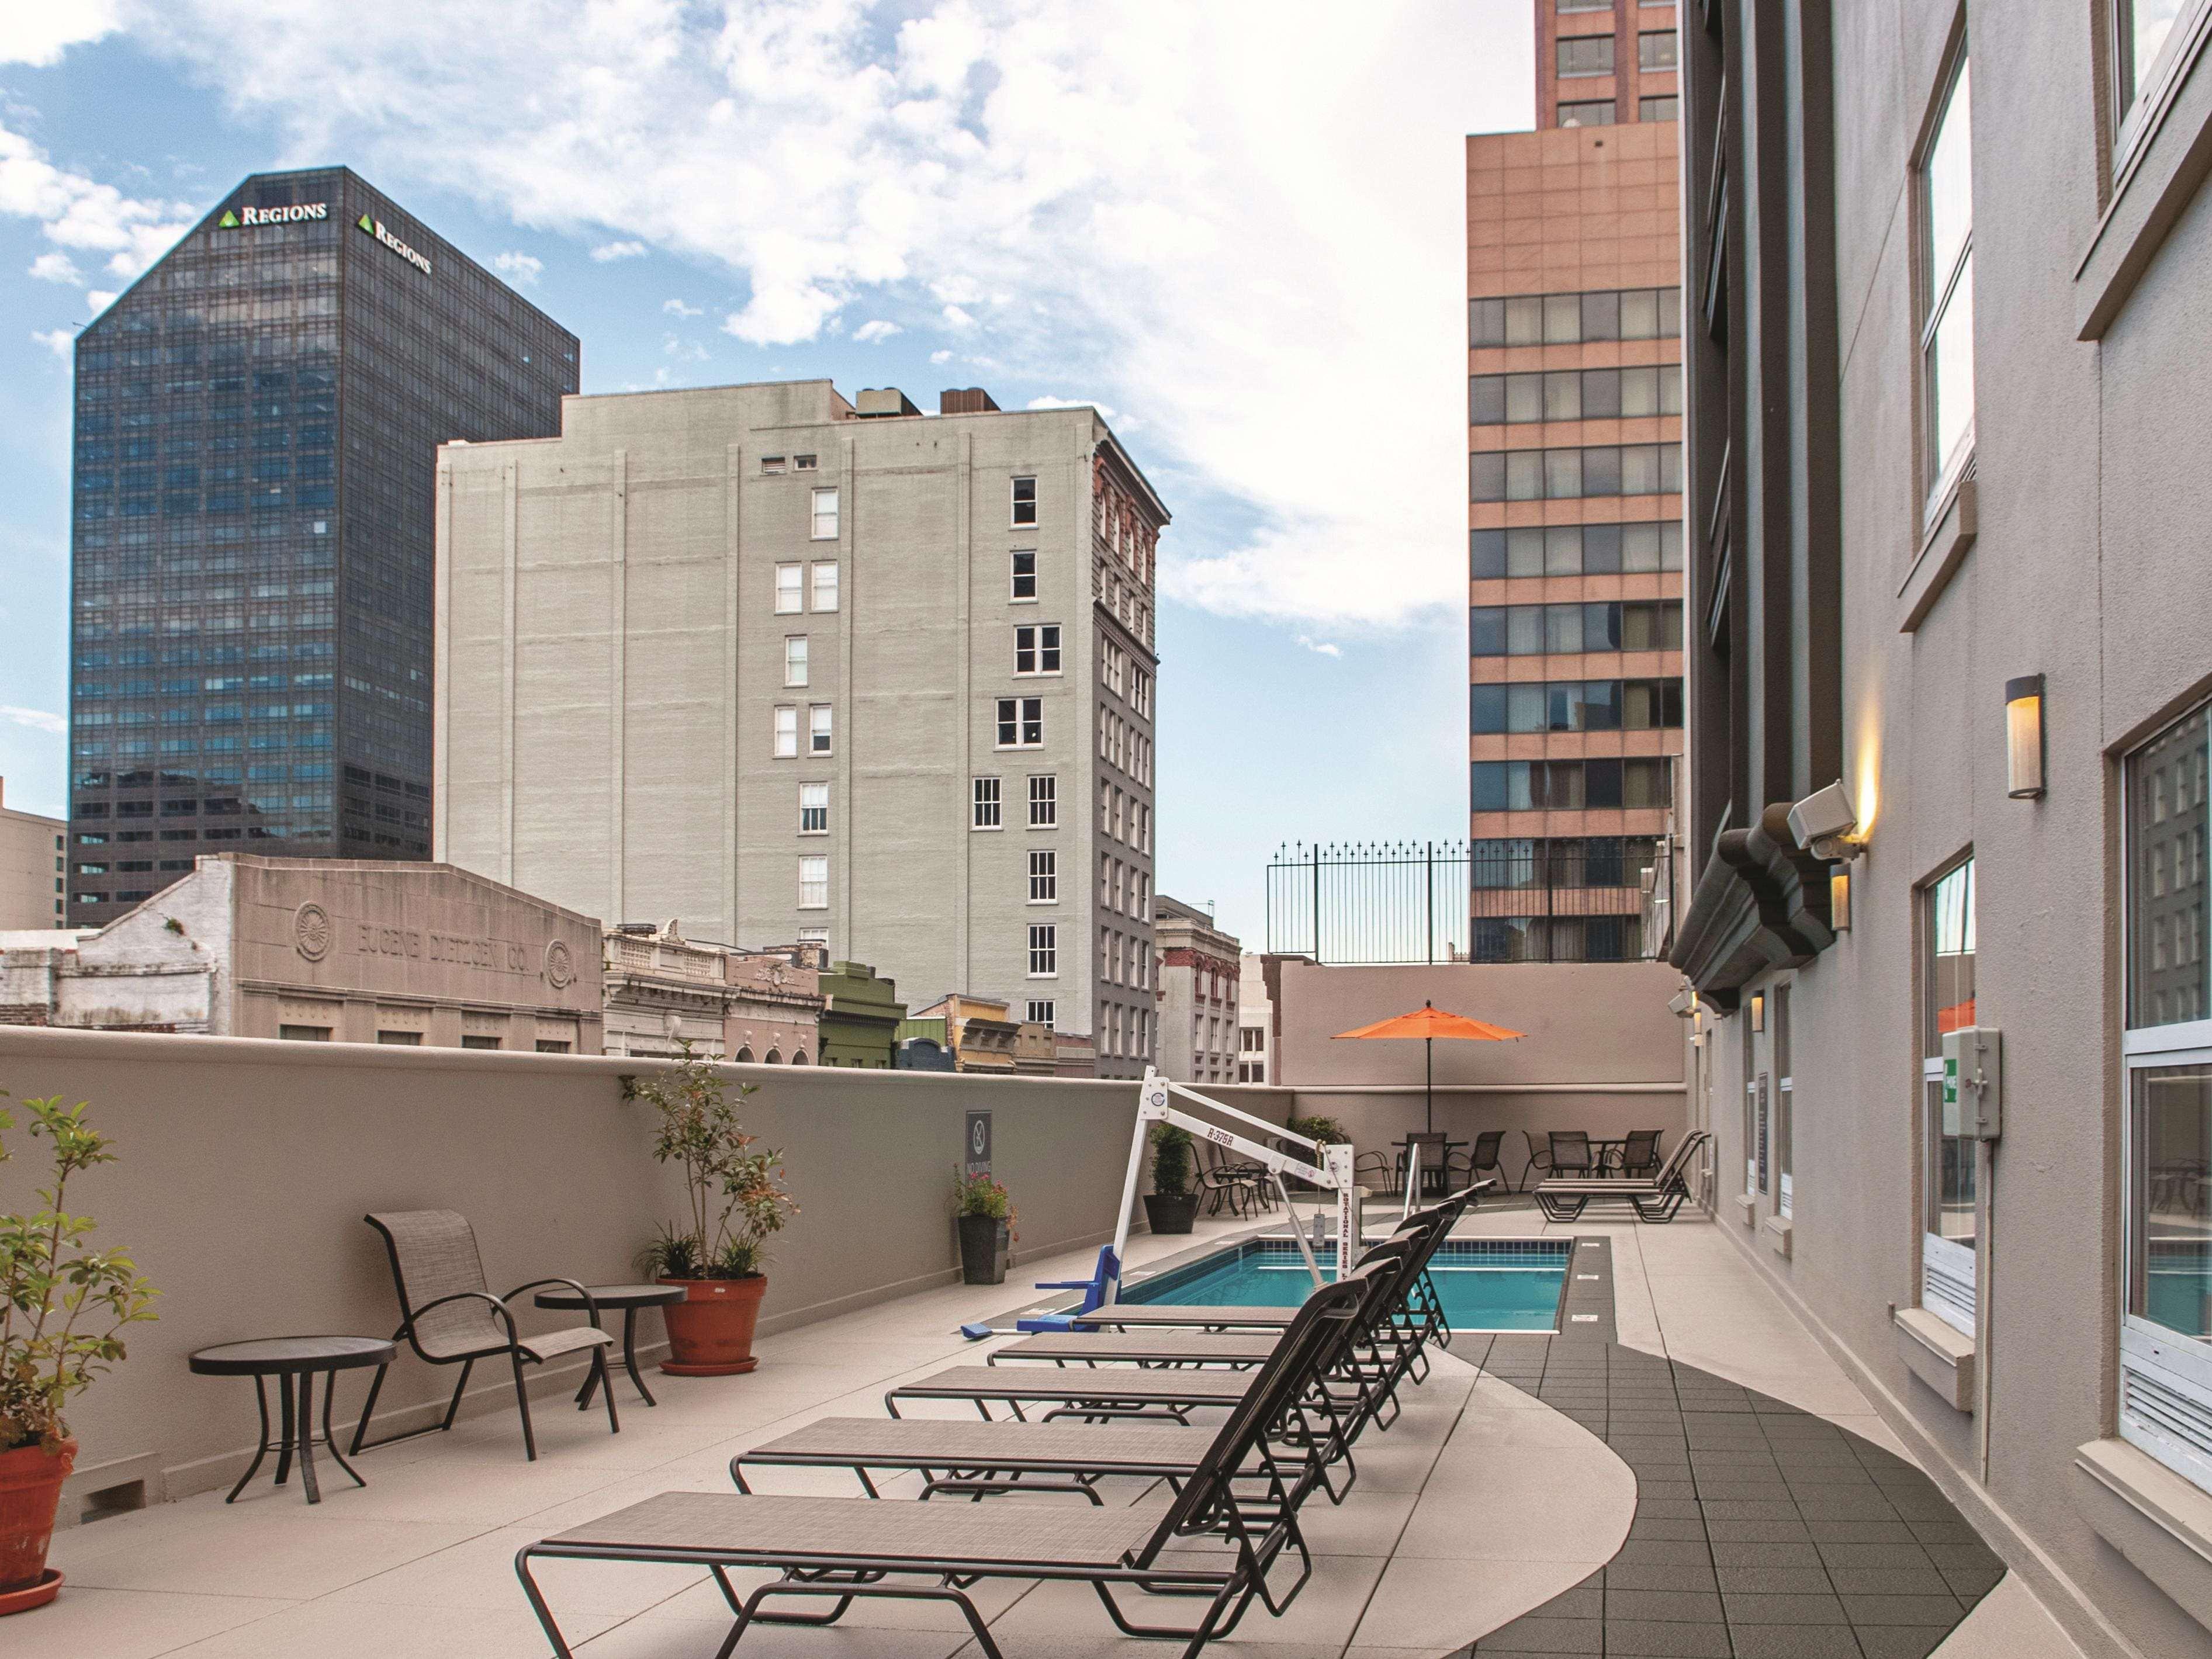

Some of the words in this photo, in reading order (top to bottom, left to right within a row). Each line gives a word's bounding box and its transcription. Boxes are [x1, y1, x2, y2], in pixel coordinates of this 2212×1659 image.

[242, 203, 328, 226] REGIONS
[375, 221, 432, 275] REGIONS
[1207, 1128, 1234, 1146] R-375R
